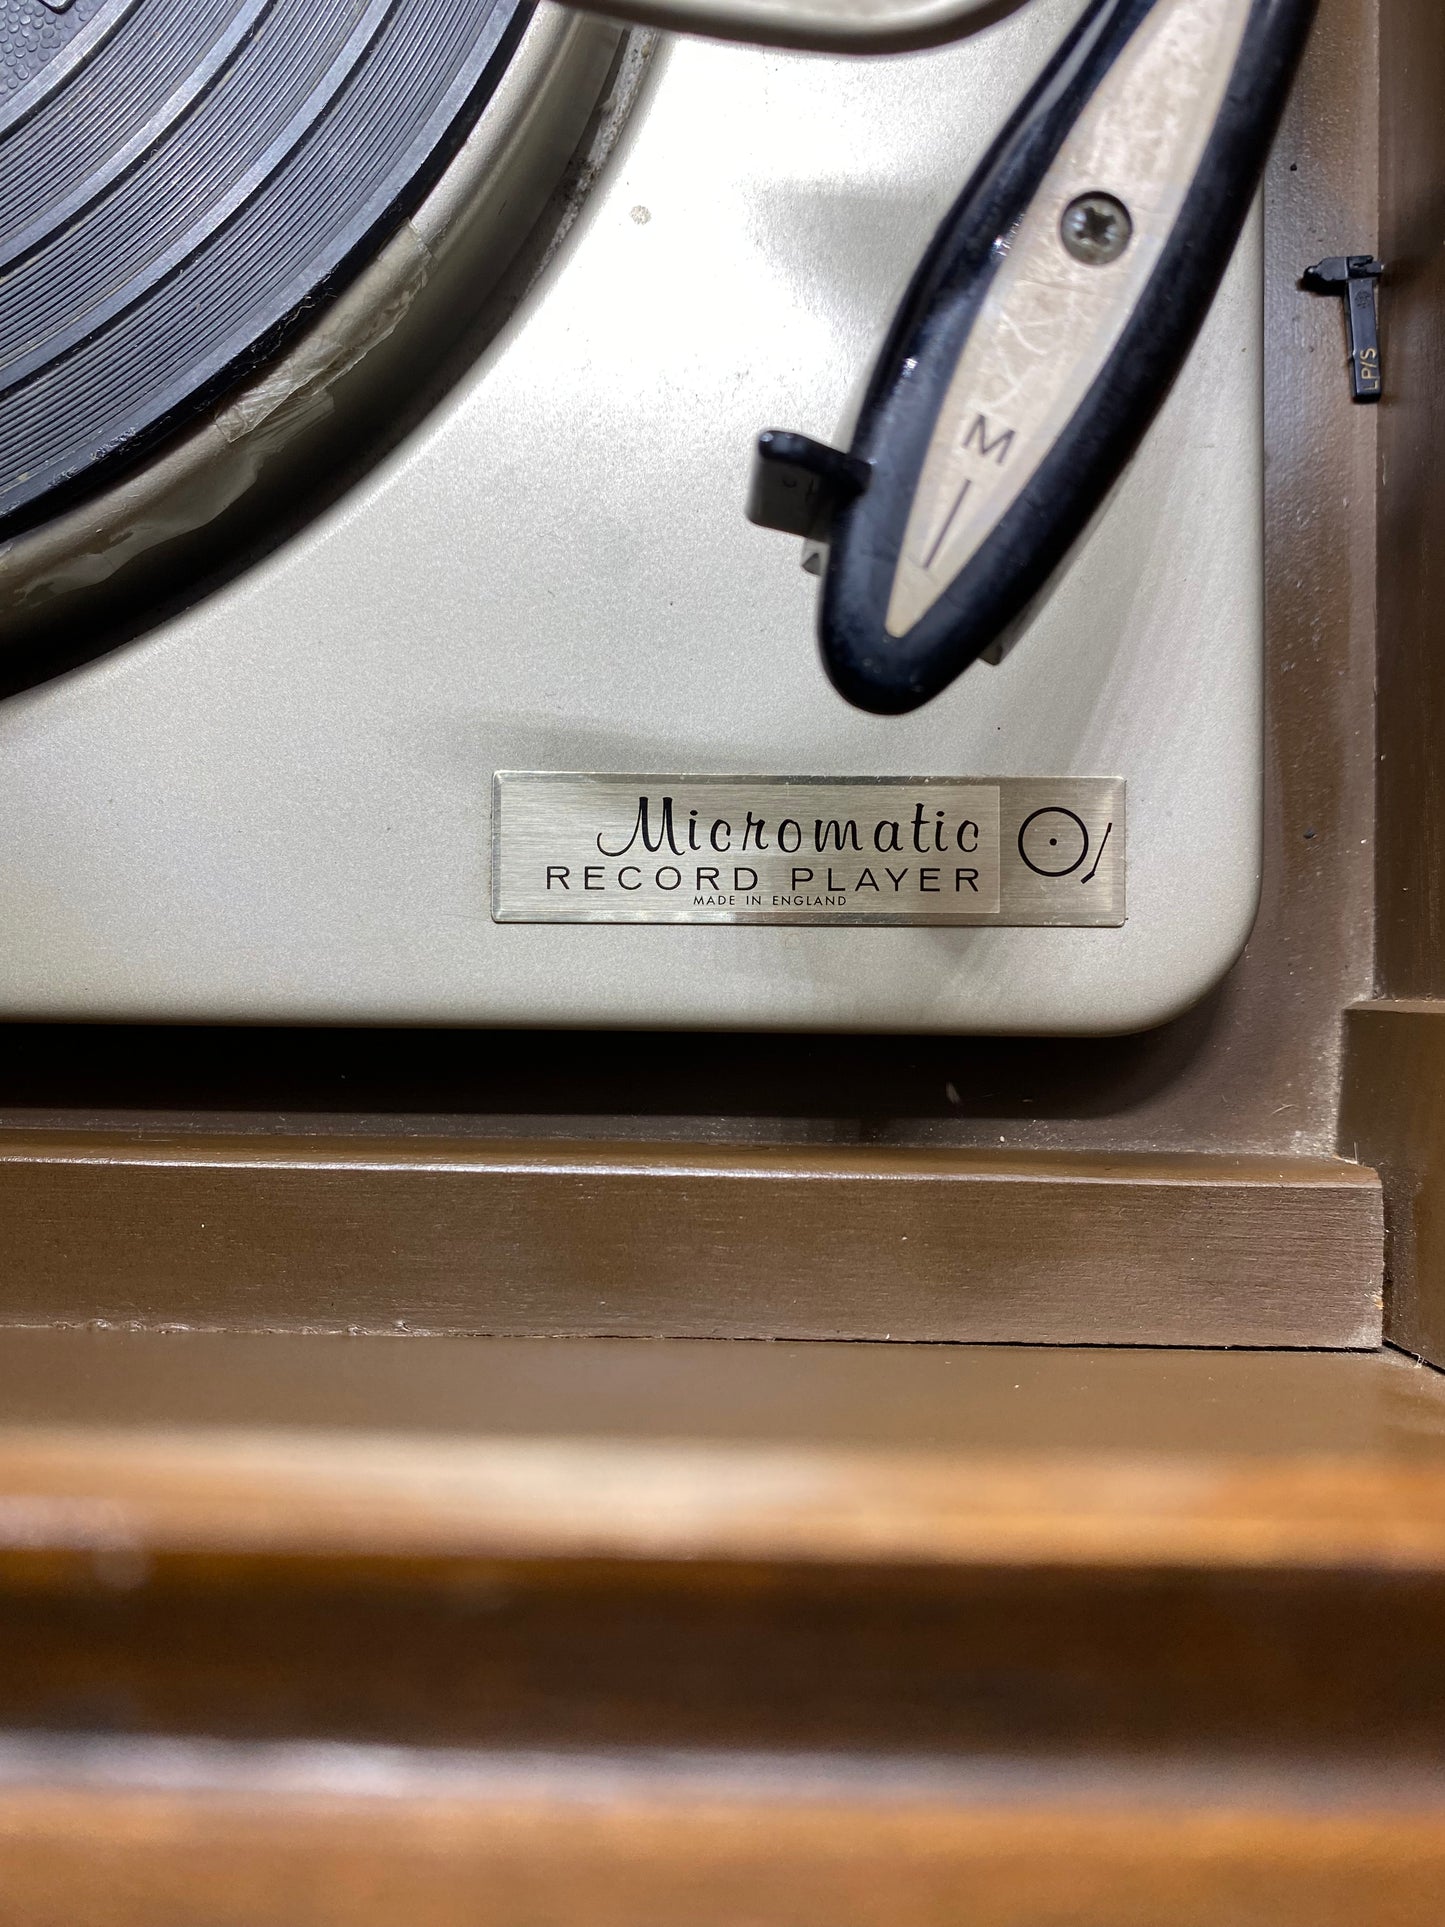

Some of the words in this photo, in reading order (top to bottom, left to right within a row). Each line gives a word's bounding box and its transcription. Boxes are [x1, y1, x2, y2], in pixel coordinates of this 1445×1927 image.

[1360, 348, 1379, 390] LP/S
[961, 412, 1016, 467] M
[596, 796, 979, 857] Micromatic
[545, 865, 759, 891] RECORD
[791, 867, 980, 893] PLAYER
[693, 895, 736, 906] MADE
[746, 895, 762, 906] IN
[772, 895, 847, 906] ENGLAND
